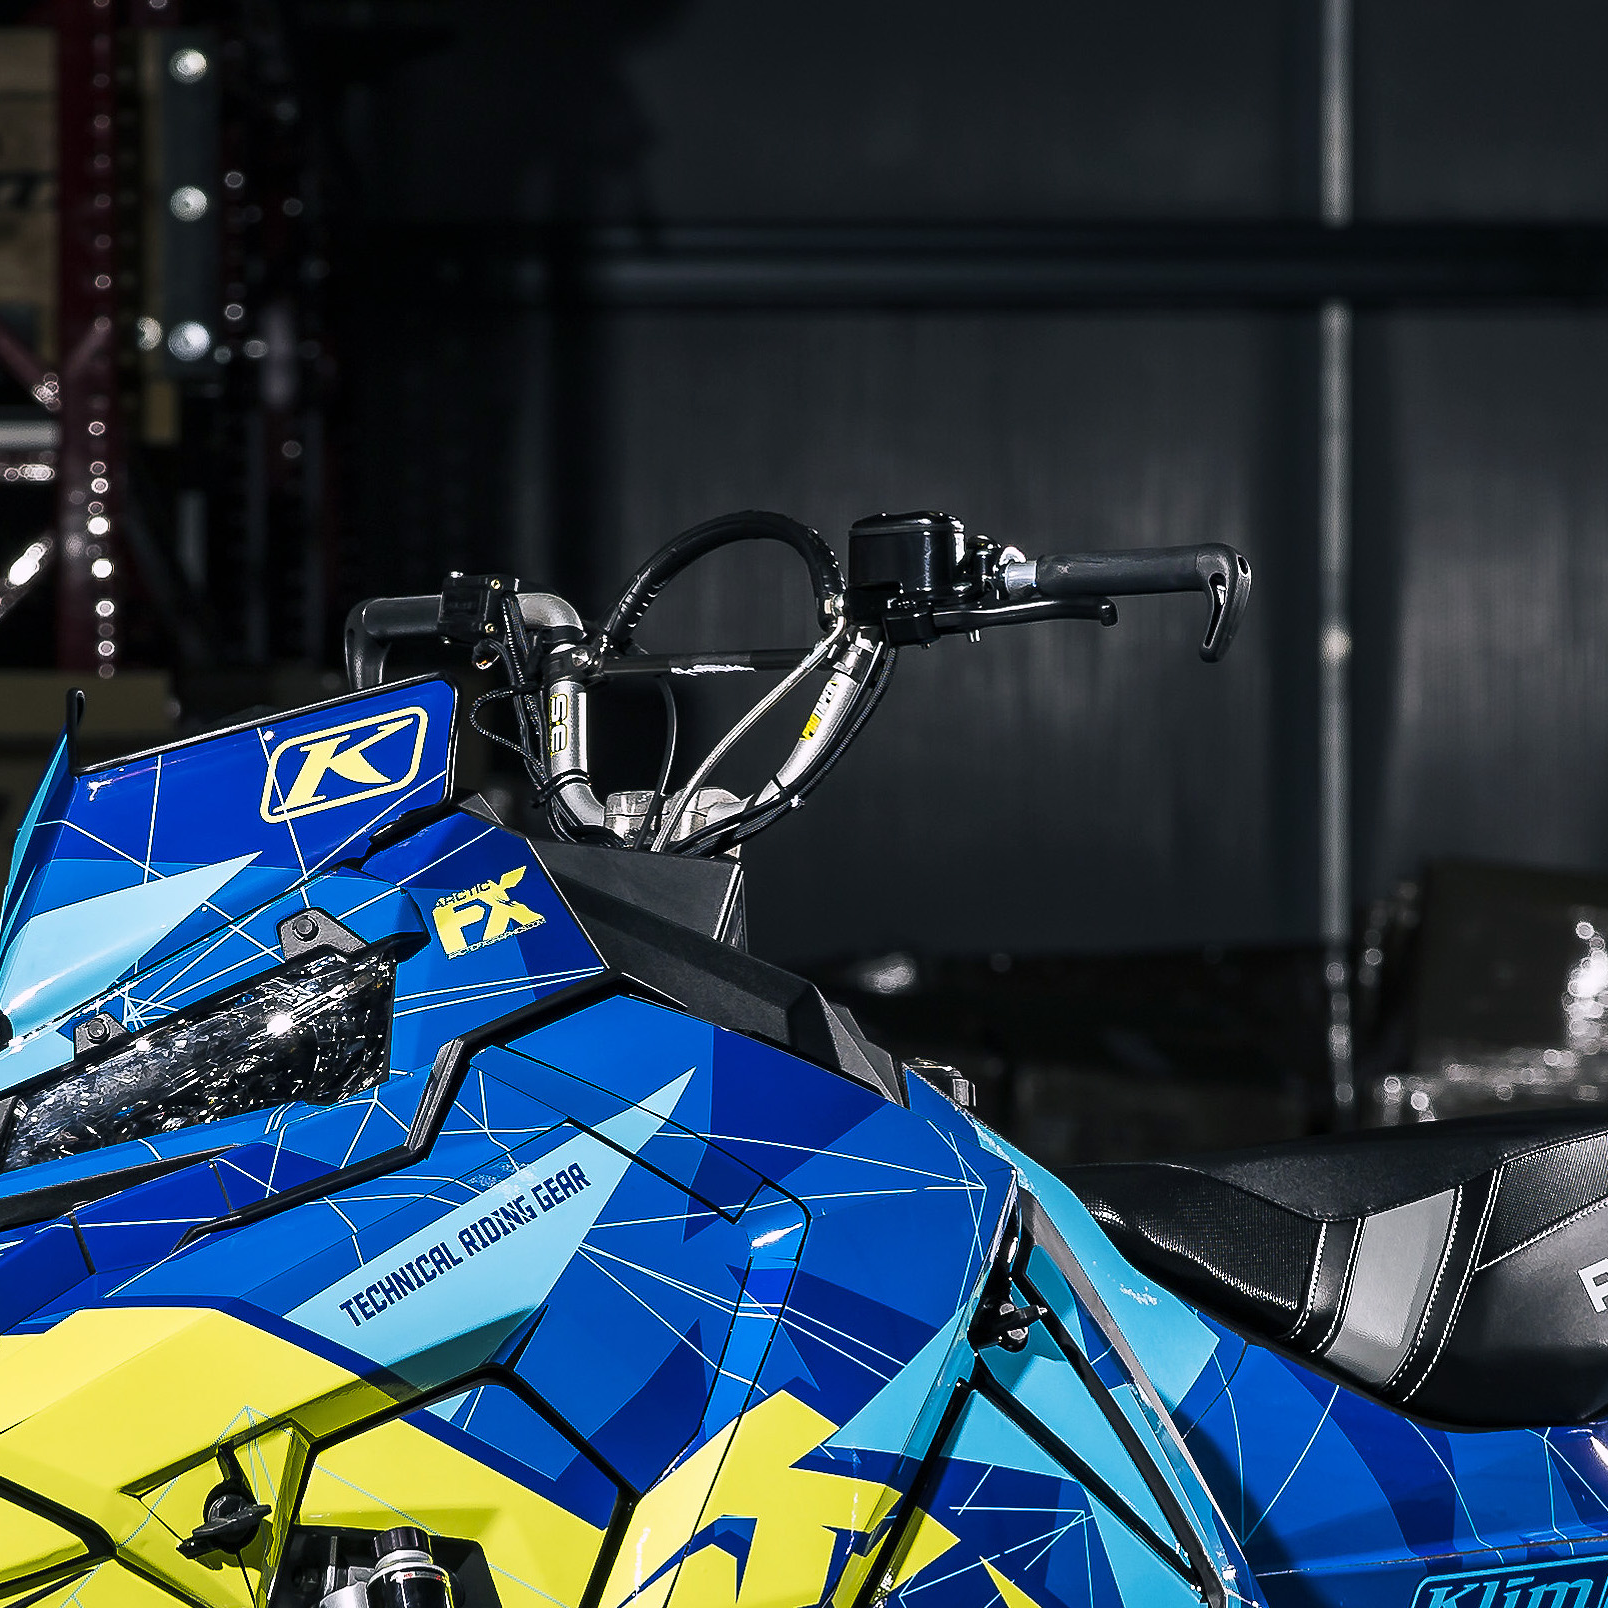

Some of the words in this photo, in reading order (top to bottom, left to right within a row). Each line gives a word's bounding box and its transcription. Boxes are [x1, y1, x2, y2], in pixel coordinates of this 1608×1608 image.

[273, 717, 414, 813] K
[432, 865, 547, 956] FX
[339, 1241, 464, 1327] TECHNICAL
[457, 1194, 539, 1256] RIDING
[530, 1162, 592, 1213] GEAR
